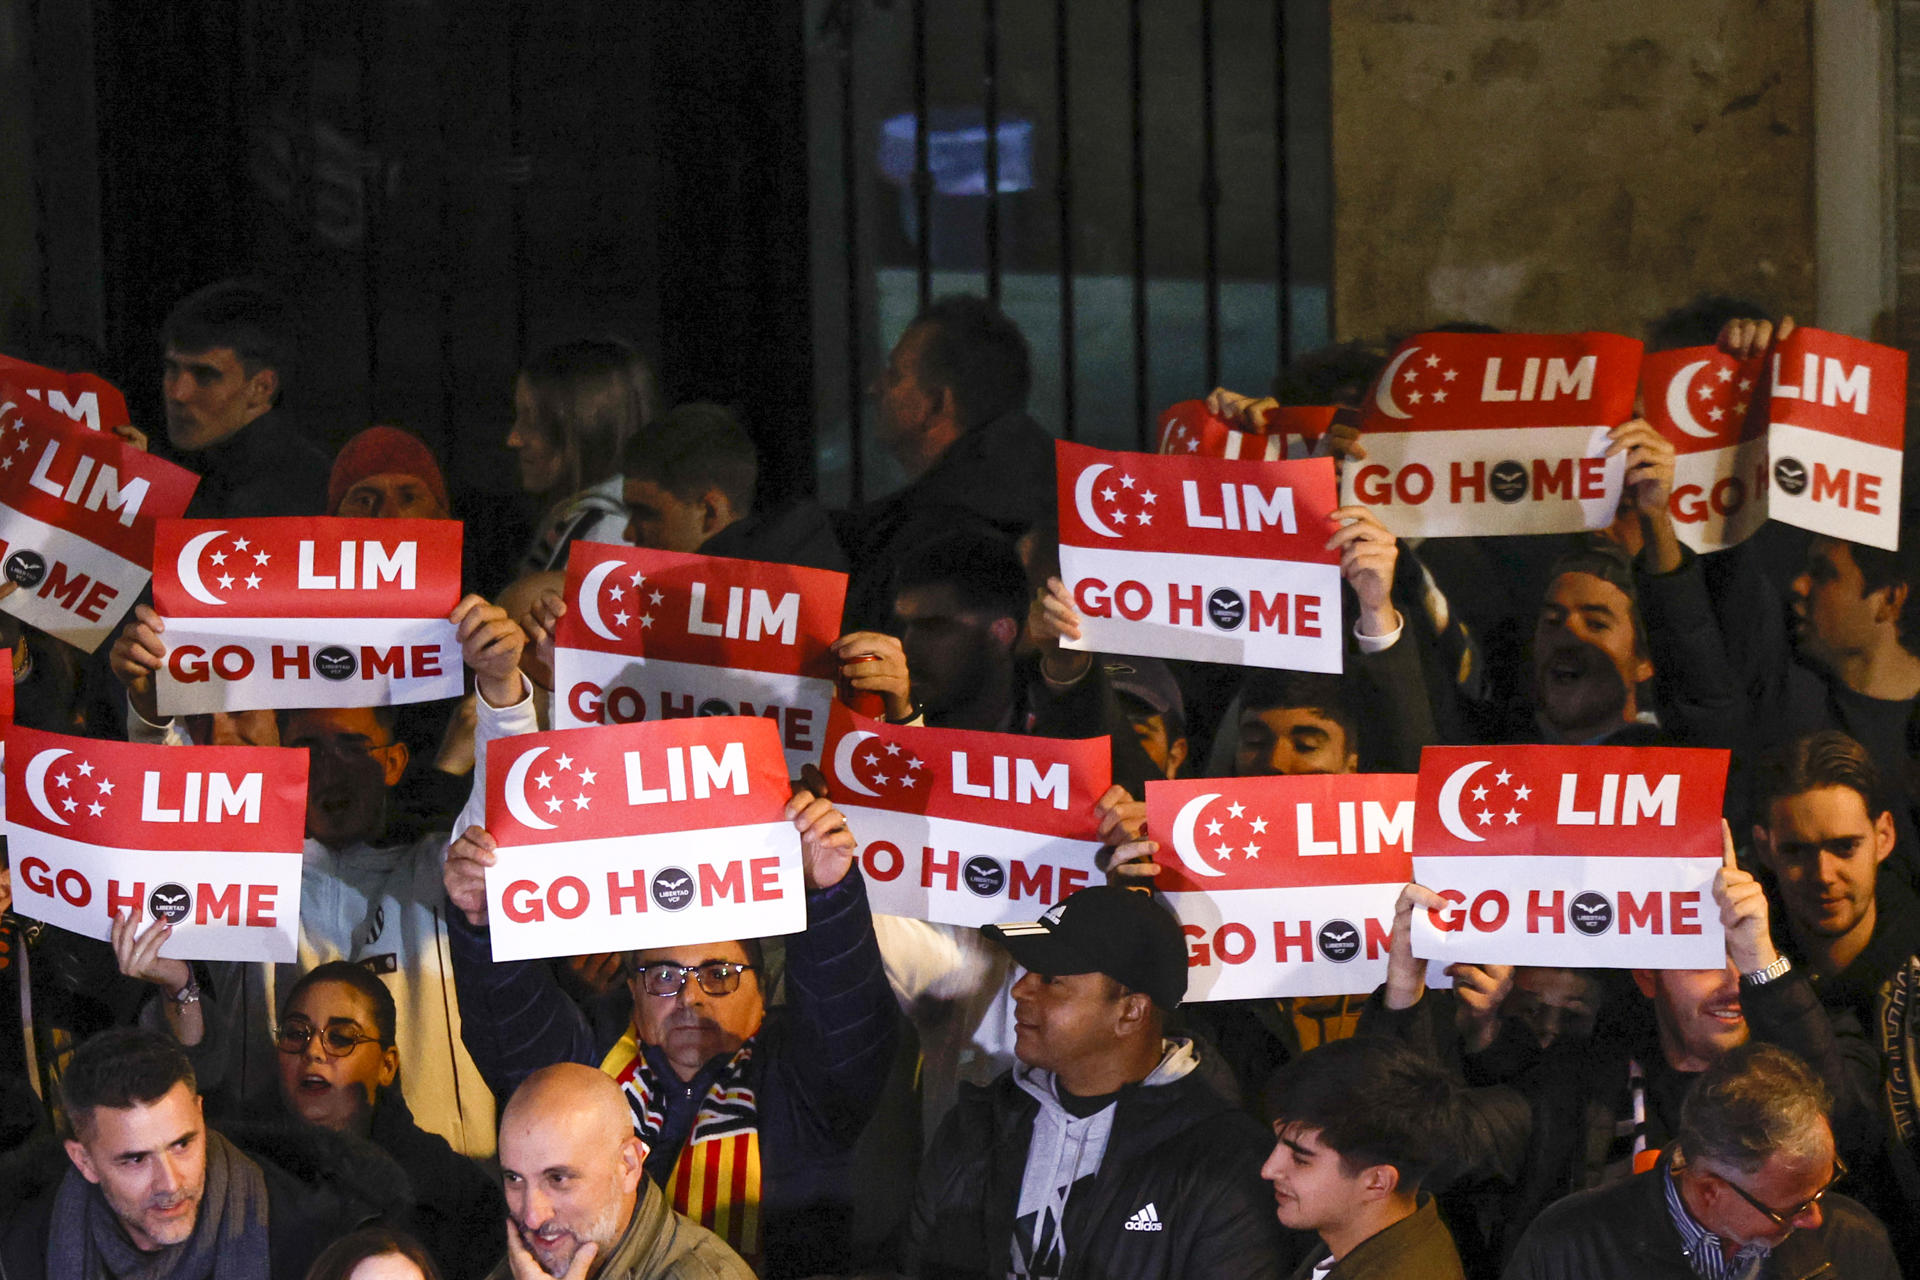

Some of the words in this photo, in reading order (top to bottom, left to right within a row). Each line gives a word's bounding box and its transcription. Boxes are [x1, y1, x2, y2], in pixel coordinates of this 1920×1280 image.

[1481, 356, 1598, 402] LIM
[1771, 352, 1871, 415] LIM
[28, 439, 151, 528] LIM
[1182, 480, 1298, 534] LIM
[1353, 463, 1434, 505] GO
[1449, 457, 1606, 505] HOME
[1669, 476, 1746, 525] GO
[0, 541, 119, 623] OME
[297, 540, 417, 590] LIM
[687, 582, 801, 645] LIM
[1074, 577, 1153, 622] GO
[1168, 583, 1322, 638] HOME
[168, 645, 255, 683] GO
[272, 644, 443, 682] HOME
[568, 681, 647, 725] GO
[141, 771, 263, 824] LIM
[624, 742, 750, 806] LIM
[951, 751, 1070, 811] LIM
[1556, 773, 1681, 826] LIM
[1296, 801, 1416, 856] LIM
[853, 840, 905, 882] O
[20, 857, 92, 907] GO
[107, 880, 279, 928] HOME
[501, 876, 590, 924] GO
[606, 857, 784, 916] HOME
[659, 889, 689, 898] LIBERTAD
[1427, 889, 1510, 933] GO
[1527, 889, 1703, 936] HOME
[1180, 922, 1257, 967] GO
[1125, 1219, 1162, 1232] adidas
